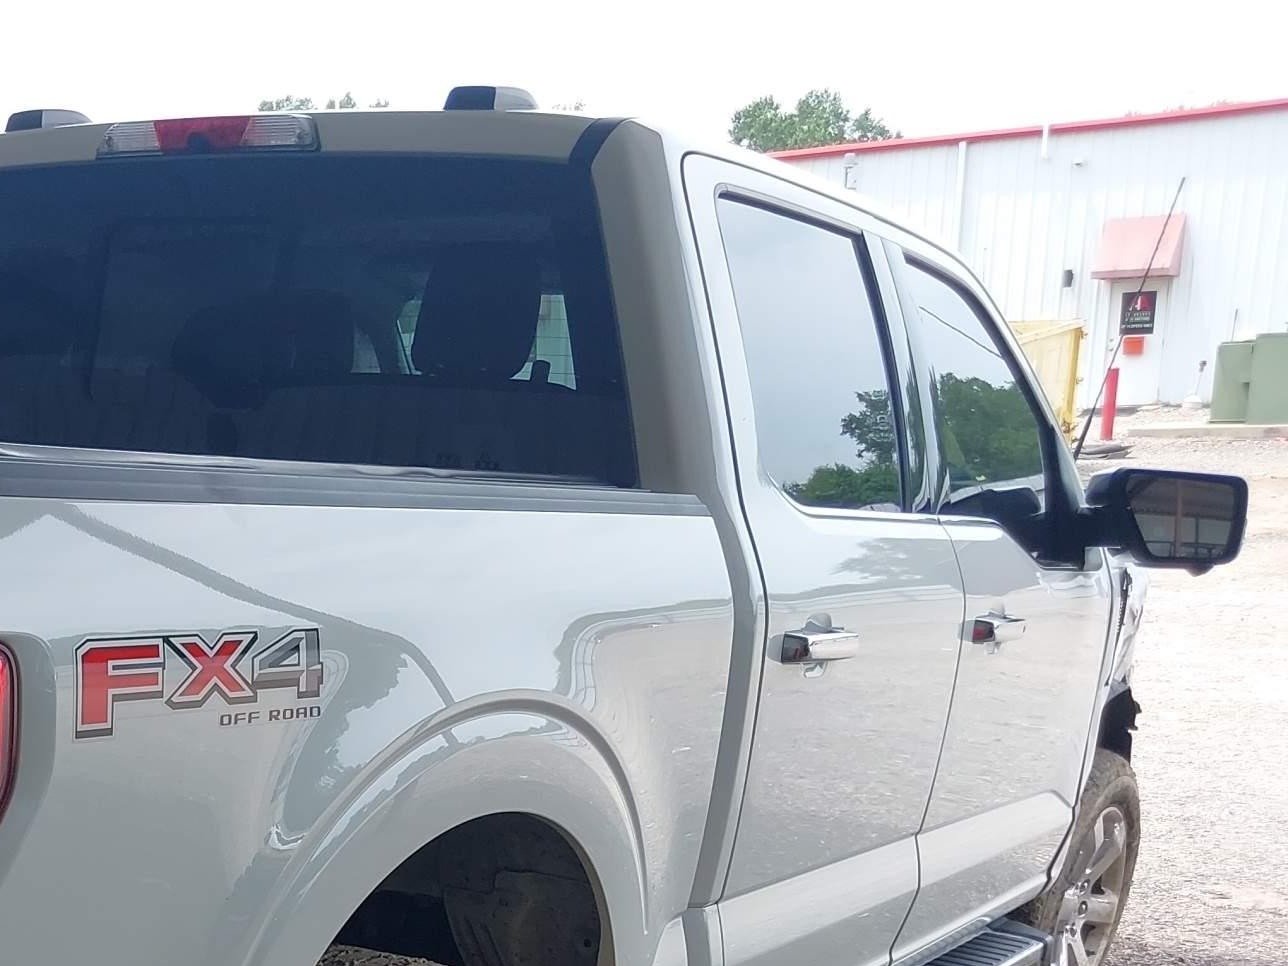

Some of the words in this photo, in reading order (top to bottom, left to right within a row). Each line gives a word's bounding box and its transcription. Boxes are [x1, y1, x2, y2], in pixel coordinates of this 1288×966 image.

[75, 628, 323, 739] FX4
[220, 712, 260, 727] OFF
[269, 706, 321, 721] ROAD
